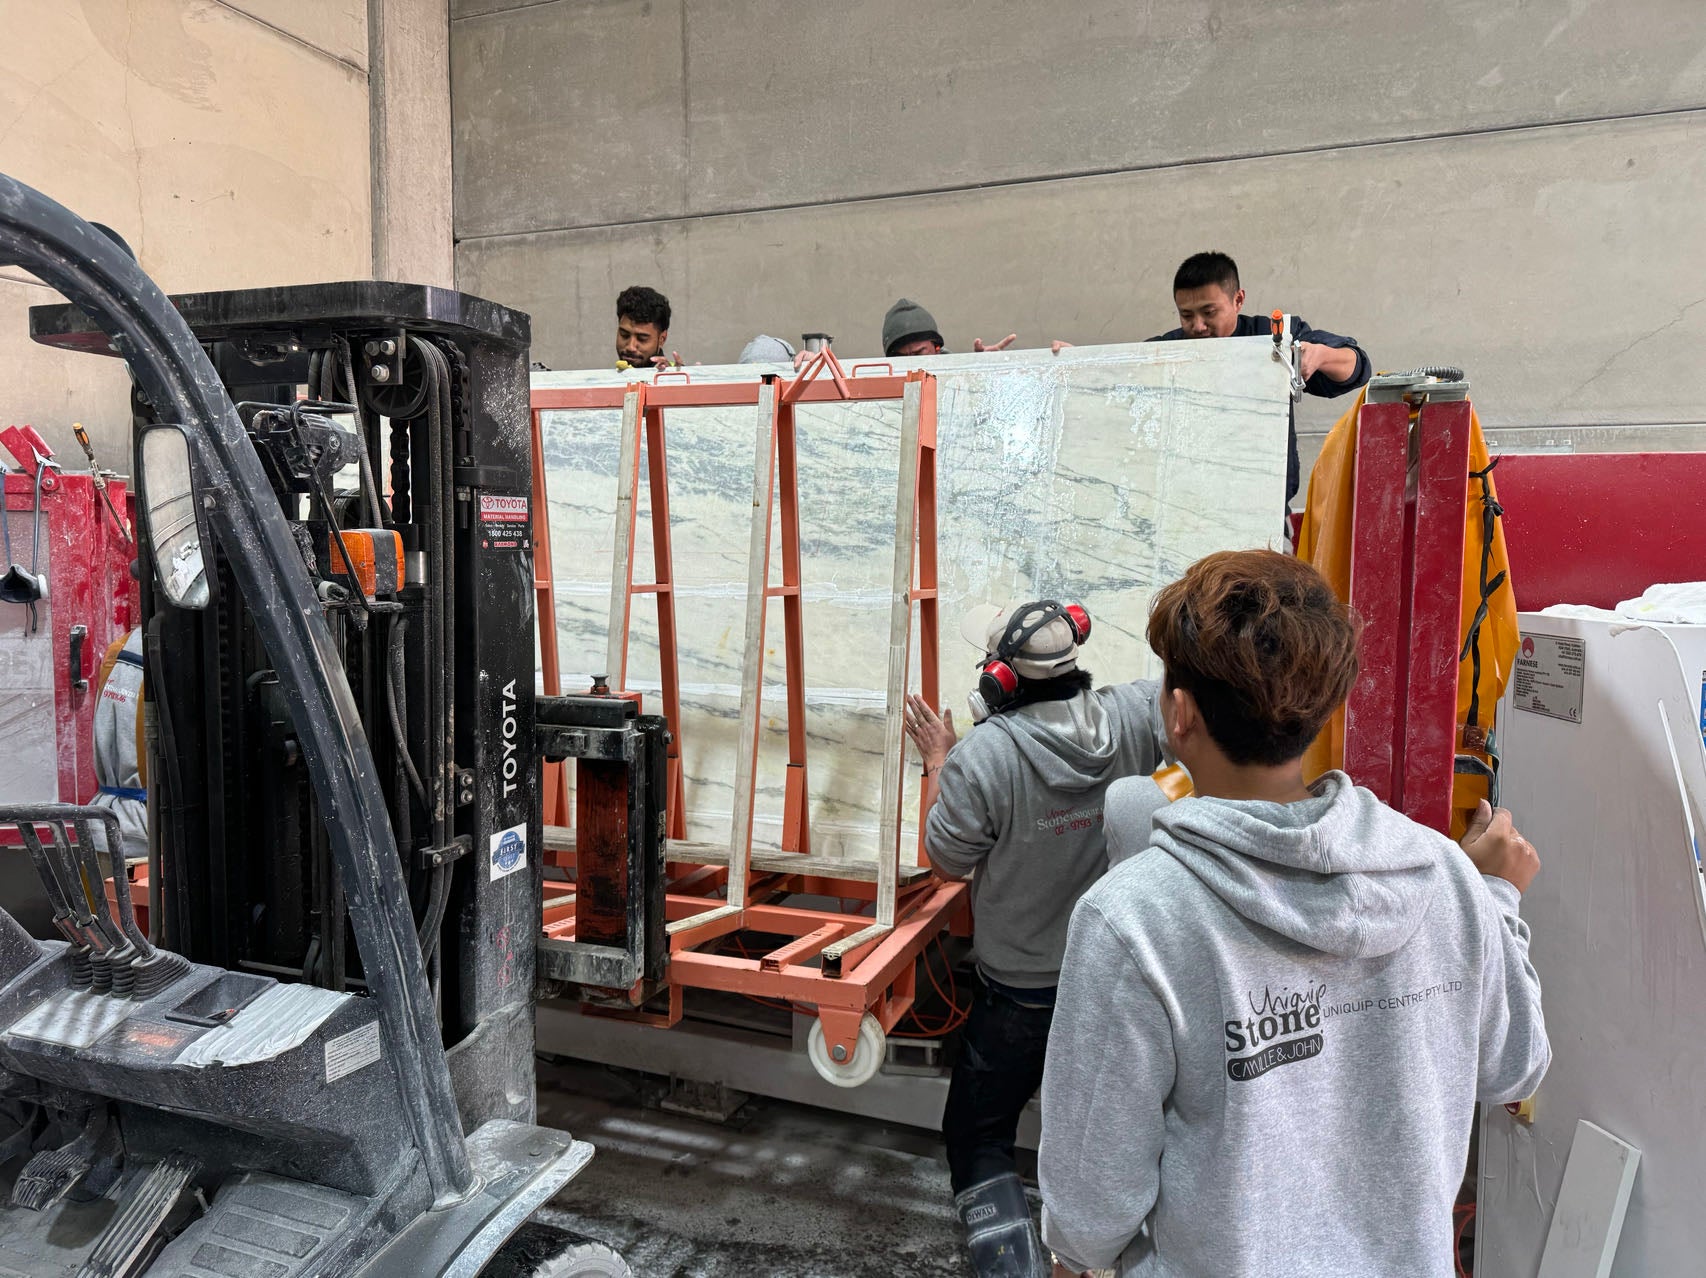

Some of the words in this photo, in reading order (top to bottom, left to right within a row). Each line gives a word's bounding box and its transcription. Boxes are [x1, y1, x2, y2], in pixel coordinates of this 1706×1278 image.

[495, 499, 527, 509] TOYOTA
[1517, 659, 1538, 668] FARNESE
[502, 678, 517, 799] TOYOTA
[500, 843, 518, 856] FIRST
[1248, 980, 1327, 1016] Uniquip
[1225, 1003, 1321, 1052] Stone
[1323, 1000, 1373, 1018] UNIQUIP
[1378, 992, 1423, 1010] CENTRE
[1425, 984, 1441, 999] PTY
[1443, 980, 1462, 993] LTD
